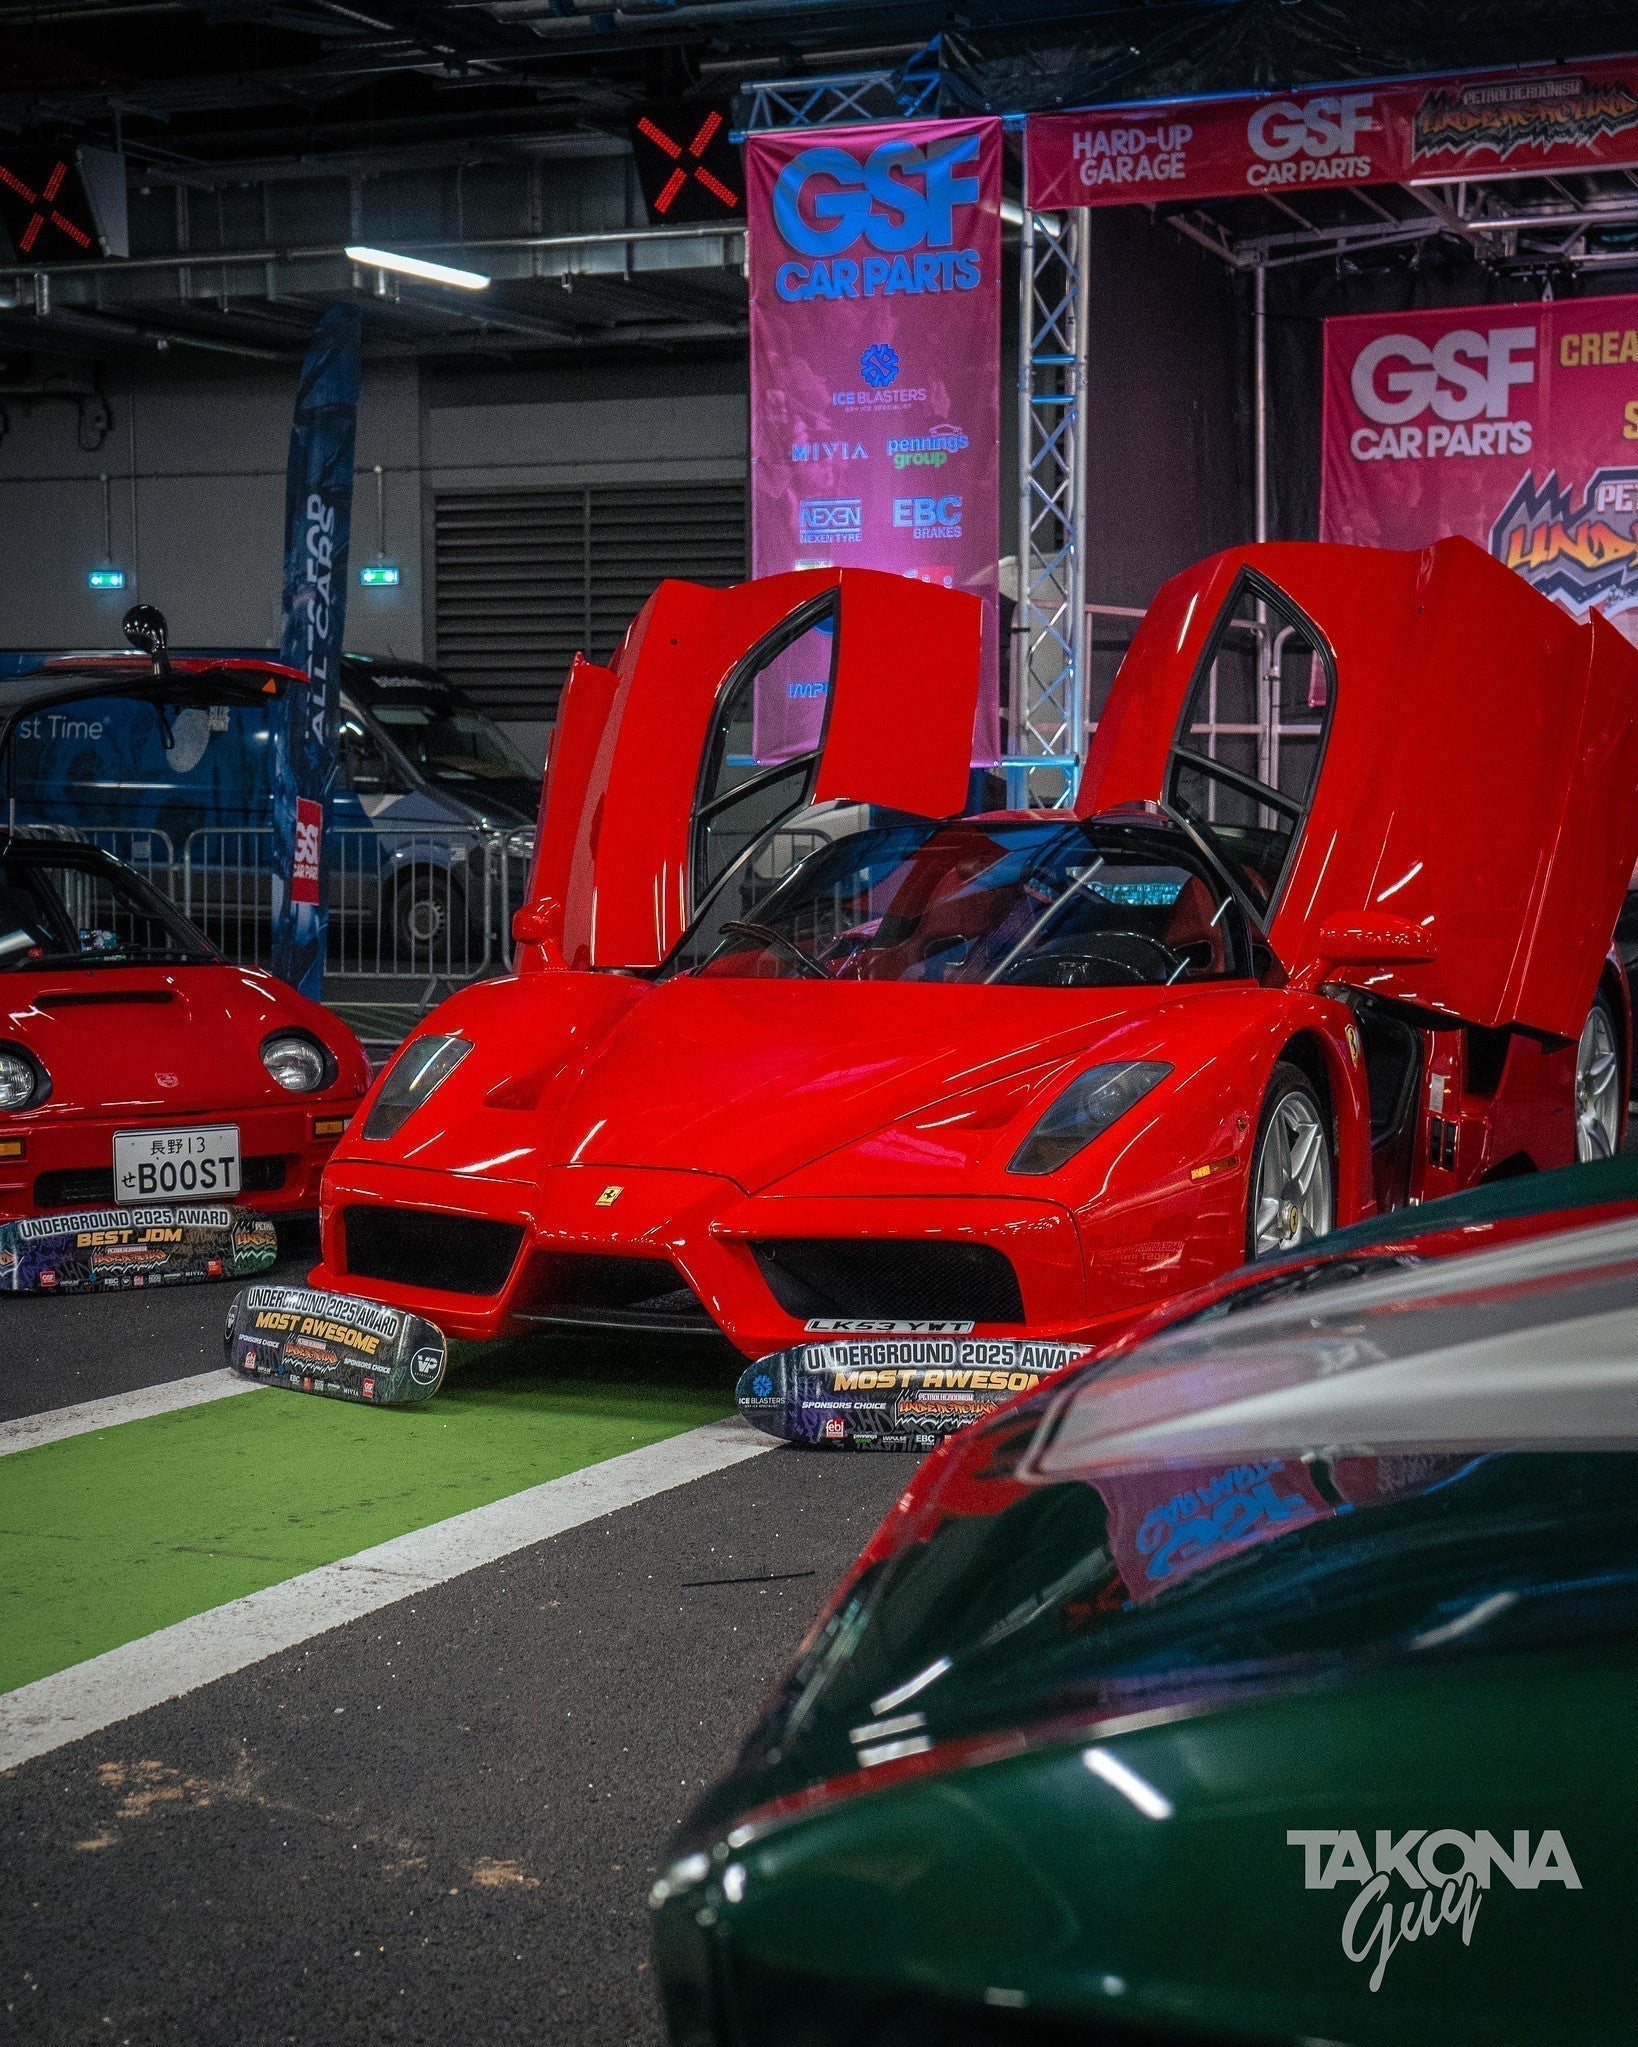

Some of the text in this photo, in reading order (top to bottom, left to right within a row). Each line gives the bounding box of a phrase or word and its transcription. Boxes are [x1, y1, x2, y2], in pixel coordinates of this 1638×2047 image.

[1072, 124, 1193, 159] HARD-UP
[1247, 92, 1373, 162] GSF
[1080, 152, 1186, 186] GARAGE
[1246, 155, 1371, 187] CAR PARTS
[773, 134, 980, 257] GSF
[776, 250, 980, 302] CAR PARTS
[1351, 327, 1536, 425] GSF
[832, 388, 927, 405] ICE BLASTERS
[792, 442, 868, 461] MIVIA
[887, 435, 969, 455] pennings
[1350, 421, 1533, 461] CAR PARTS
[893, 451, 947, 469] group
[893, 495, 962, 527] EBC
[1598, 483, 1638, 512] PE
[801, 507, 861, 527] NEXEN
[800, 533, 861, 544] NEXEN TYRE
[914, 526, 962, 539] BRAKES
[1507, 521, 1638, 570] UND
[312, 506, 334, 745] ALL CARS
[188, 1136, 205, 1154] 13
[138, 1156, 235, 1194] BOOST
[21, 1209, 228, 1239] UNDERGROUND 2025 AWARD
[77, 1228, 182, 1248] BEST JDM
[249, 1289, 397, 1337] UNDERGROUND 2025 AWARD
[811, 1320, 969, 1332] LK53 YWT
[255, 1312, 300, 1332] MOST
[300, 1317, 379, 1354] AWESOME
[418, 1355, 438, 1373] VP
[806, 1343, 954, 1370] UNDERGROUND
[962, 1343, 1014, 1366] 2025
[833, 1369, 917, 1391] MOST
[802, 1401, 852, 1409] SPONSORS
